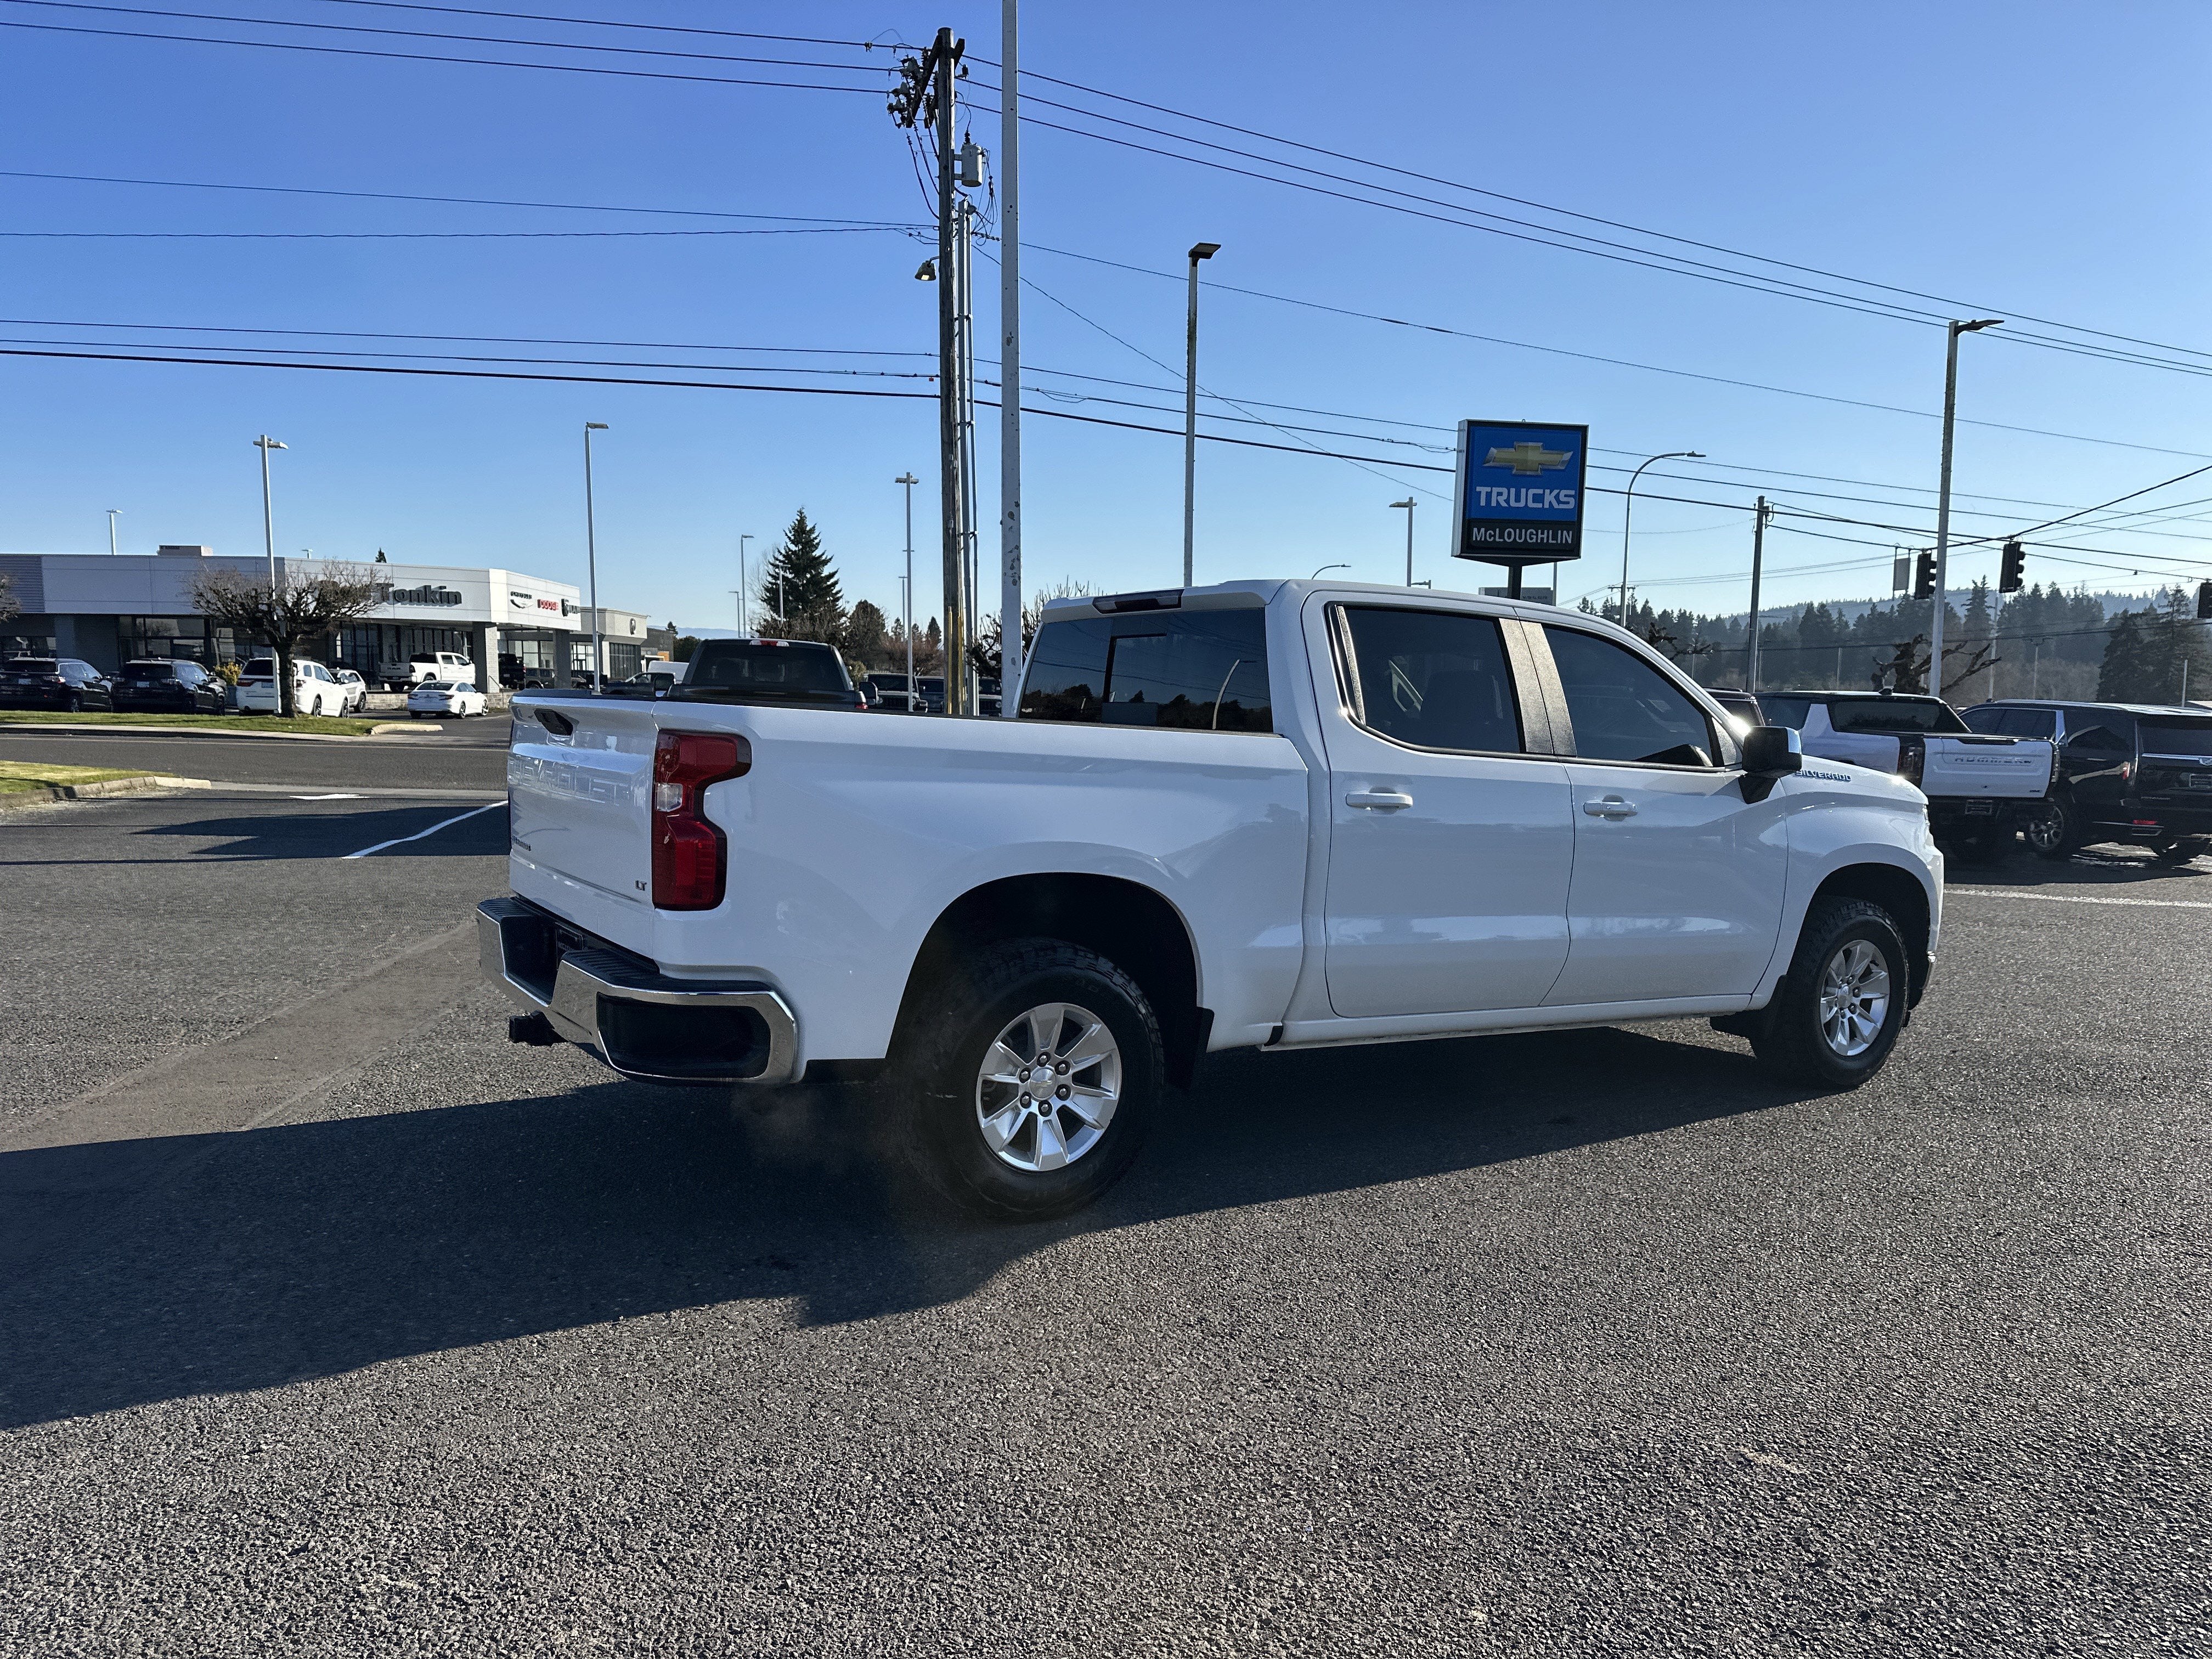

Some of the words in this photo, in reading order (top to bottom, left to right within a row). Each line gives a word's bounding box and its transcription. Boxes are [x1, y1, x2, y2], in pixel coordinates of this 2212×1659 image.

[1476, 486, 1576, 509] TRUCKS
[1472, 527, 1573, 544] McLOUGHLIN
[375, 583, 462, 605] Tonkin
[635, 880, 647, 891] LT
